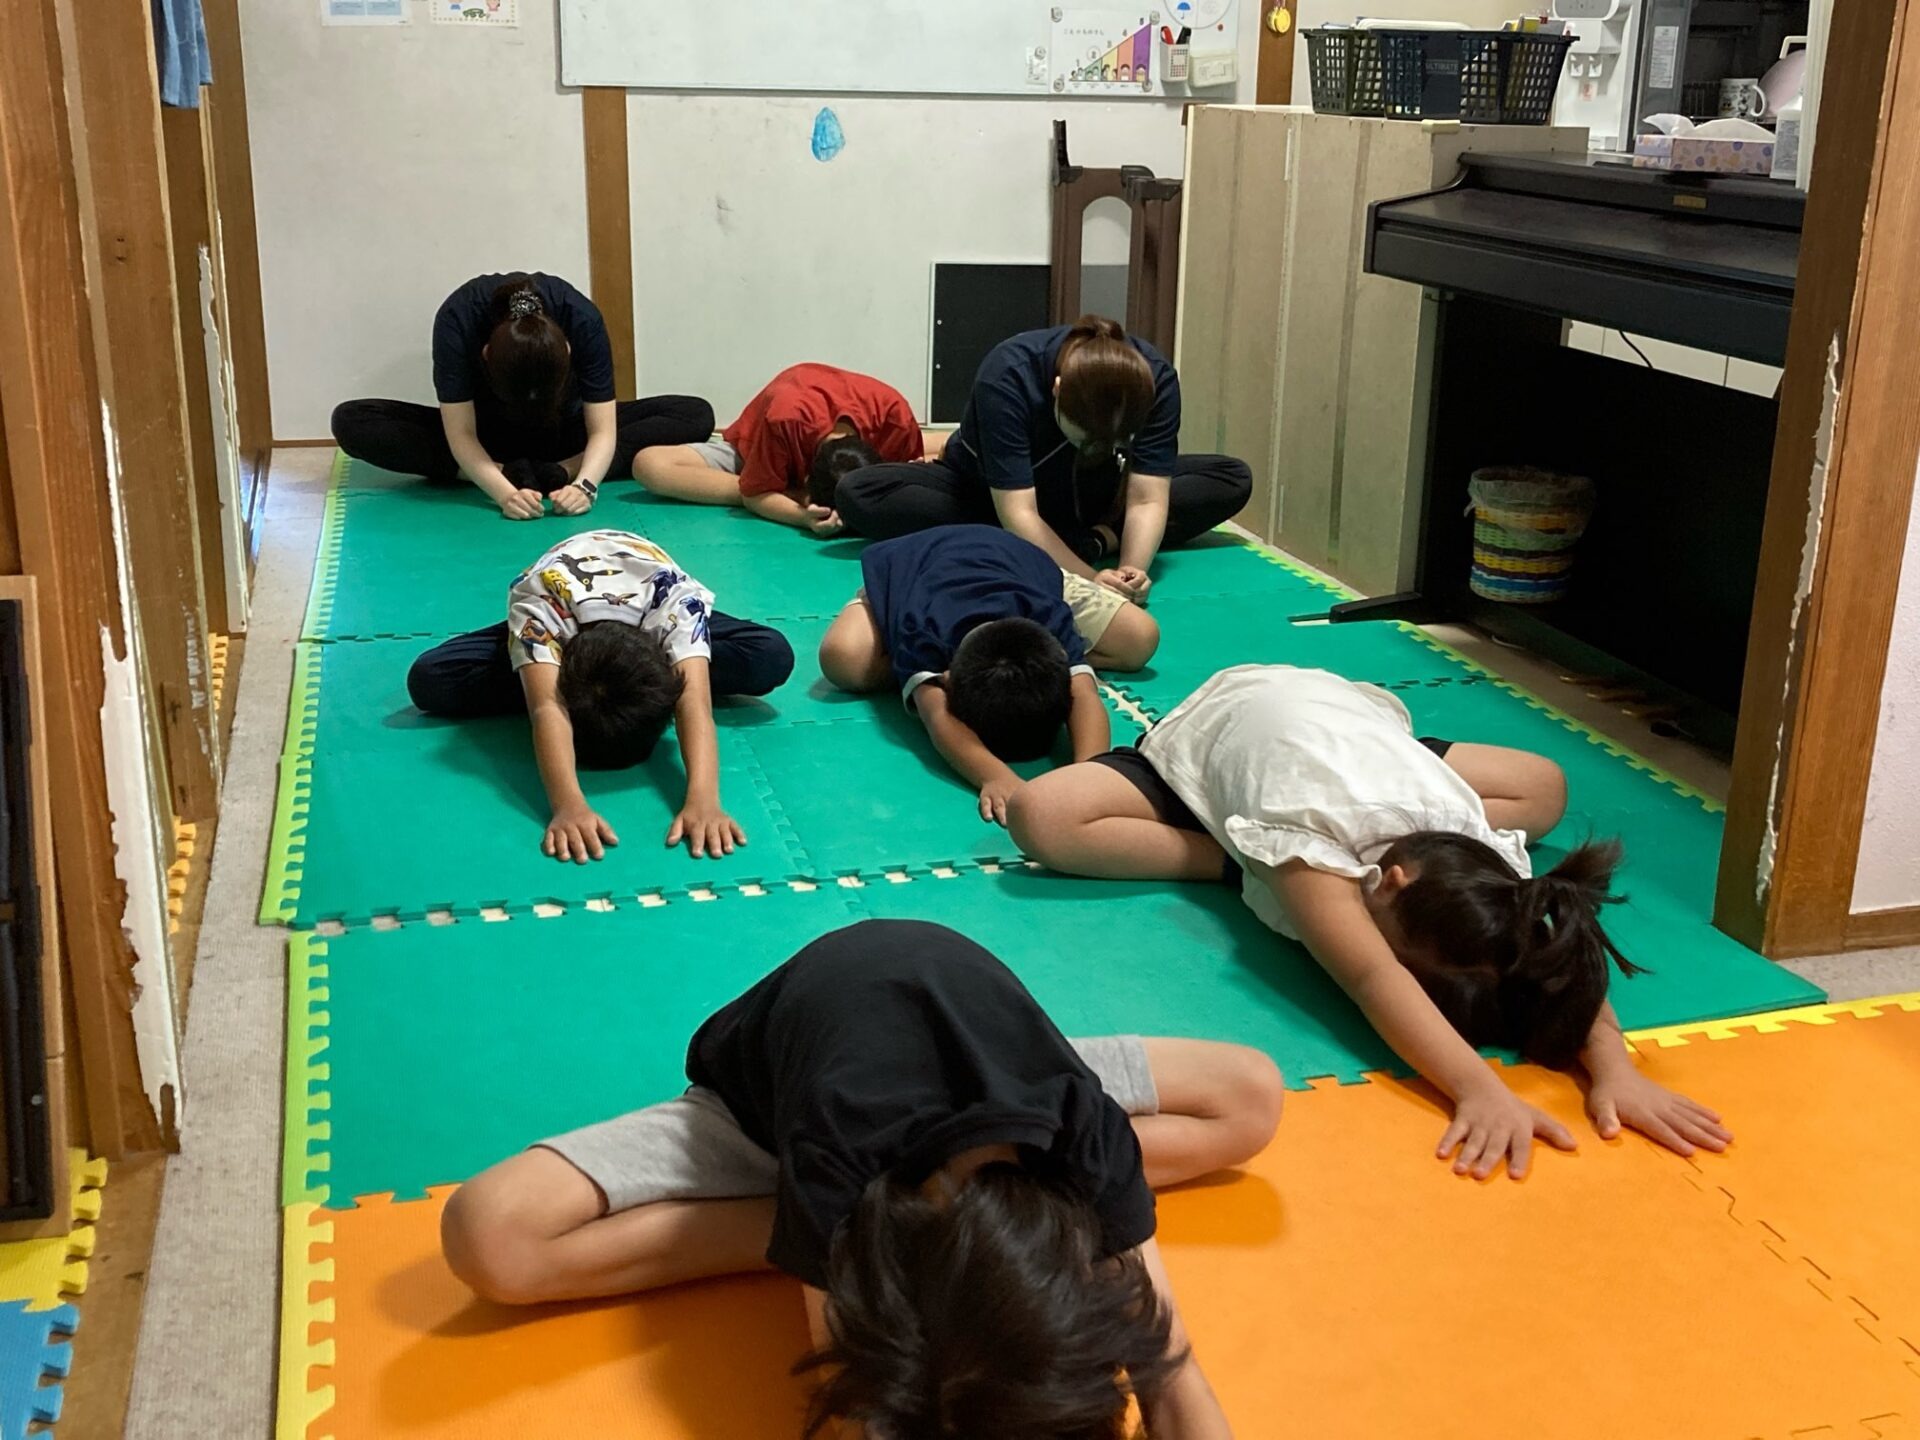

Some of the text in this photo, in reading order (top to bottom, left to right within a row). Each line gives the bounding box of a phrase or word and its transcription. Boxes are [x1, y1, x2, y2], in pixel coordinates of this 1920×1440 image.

[1122, 28, 1127, 37] 4
[1107, 40, 1112, 48] 3
[1091, 51, 1096, 59] 2
